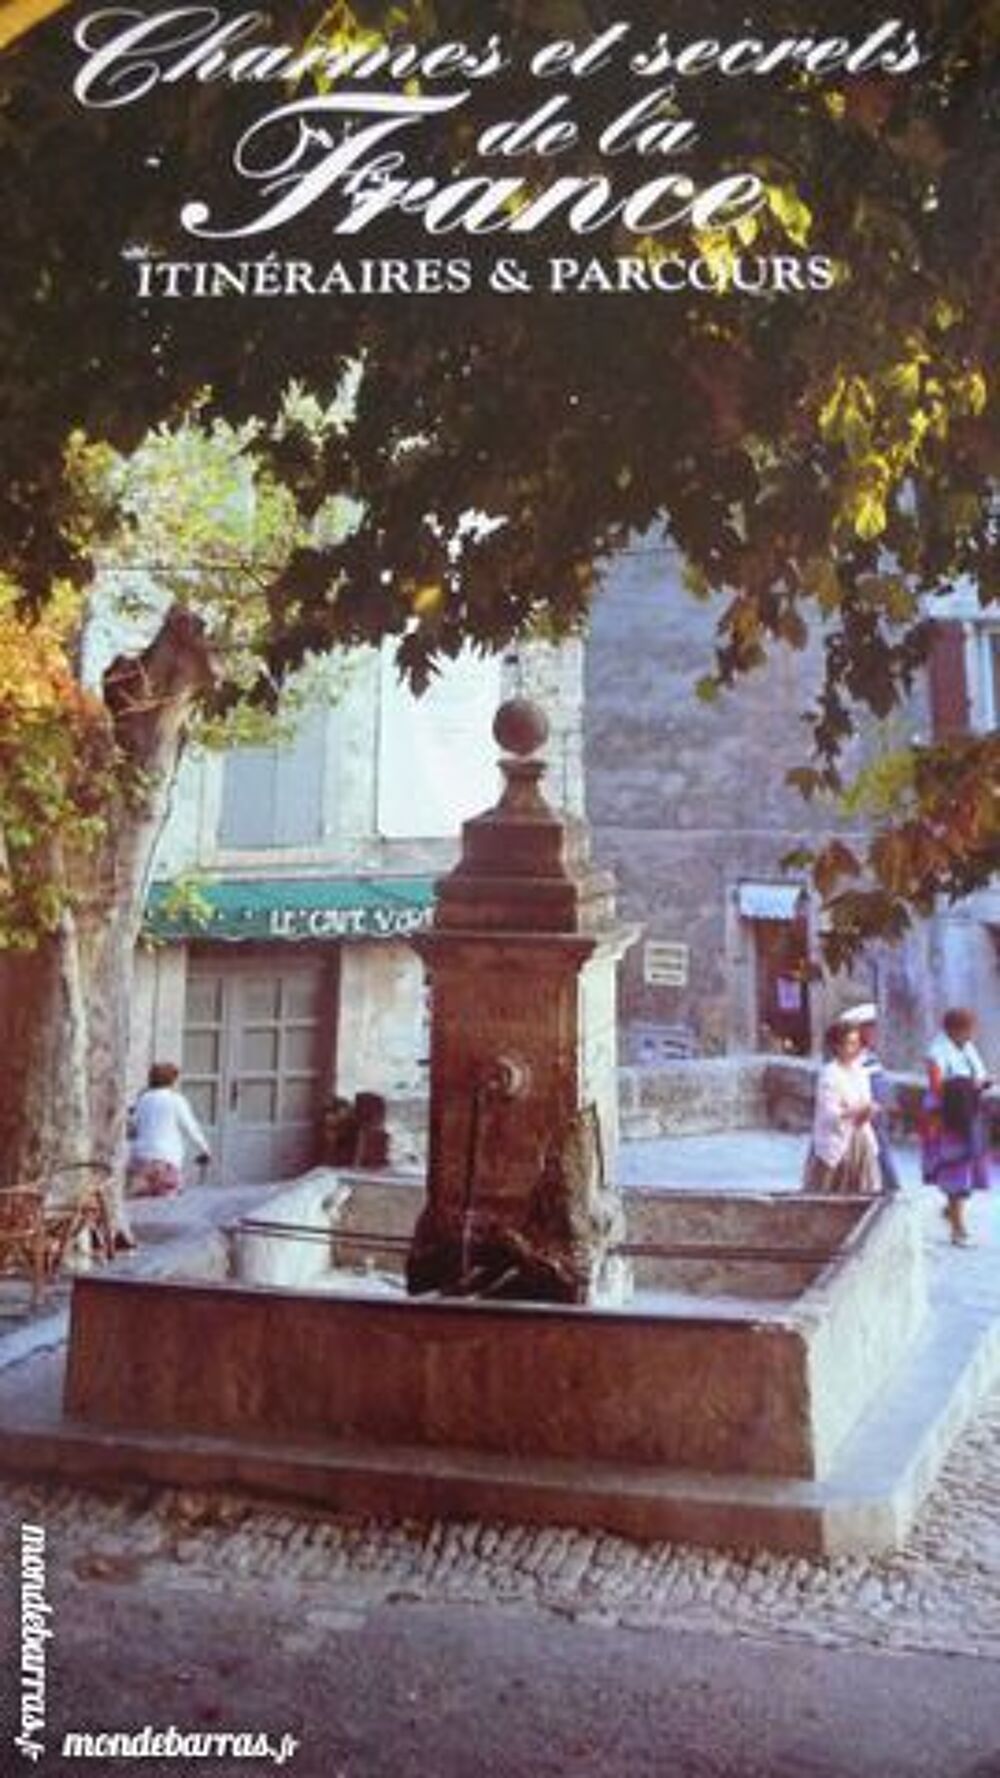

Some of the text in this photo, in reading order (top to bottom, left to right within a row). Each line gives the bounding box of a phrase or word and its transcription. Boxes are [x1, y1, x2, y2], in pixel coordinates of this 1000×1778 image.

[73, 6, 924, 108] Charmes et secrets
[477, 83, 699, 156] de la
[180, 89, 768, 238] France
[136, 250, 836, 298] ITINÉRAIRES & PARCOURS
